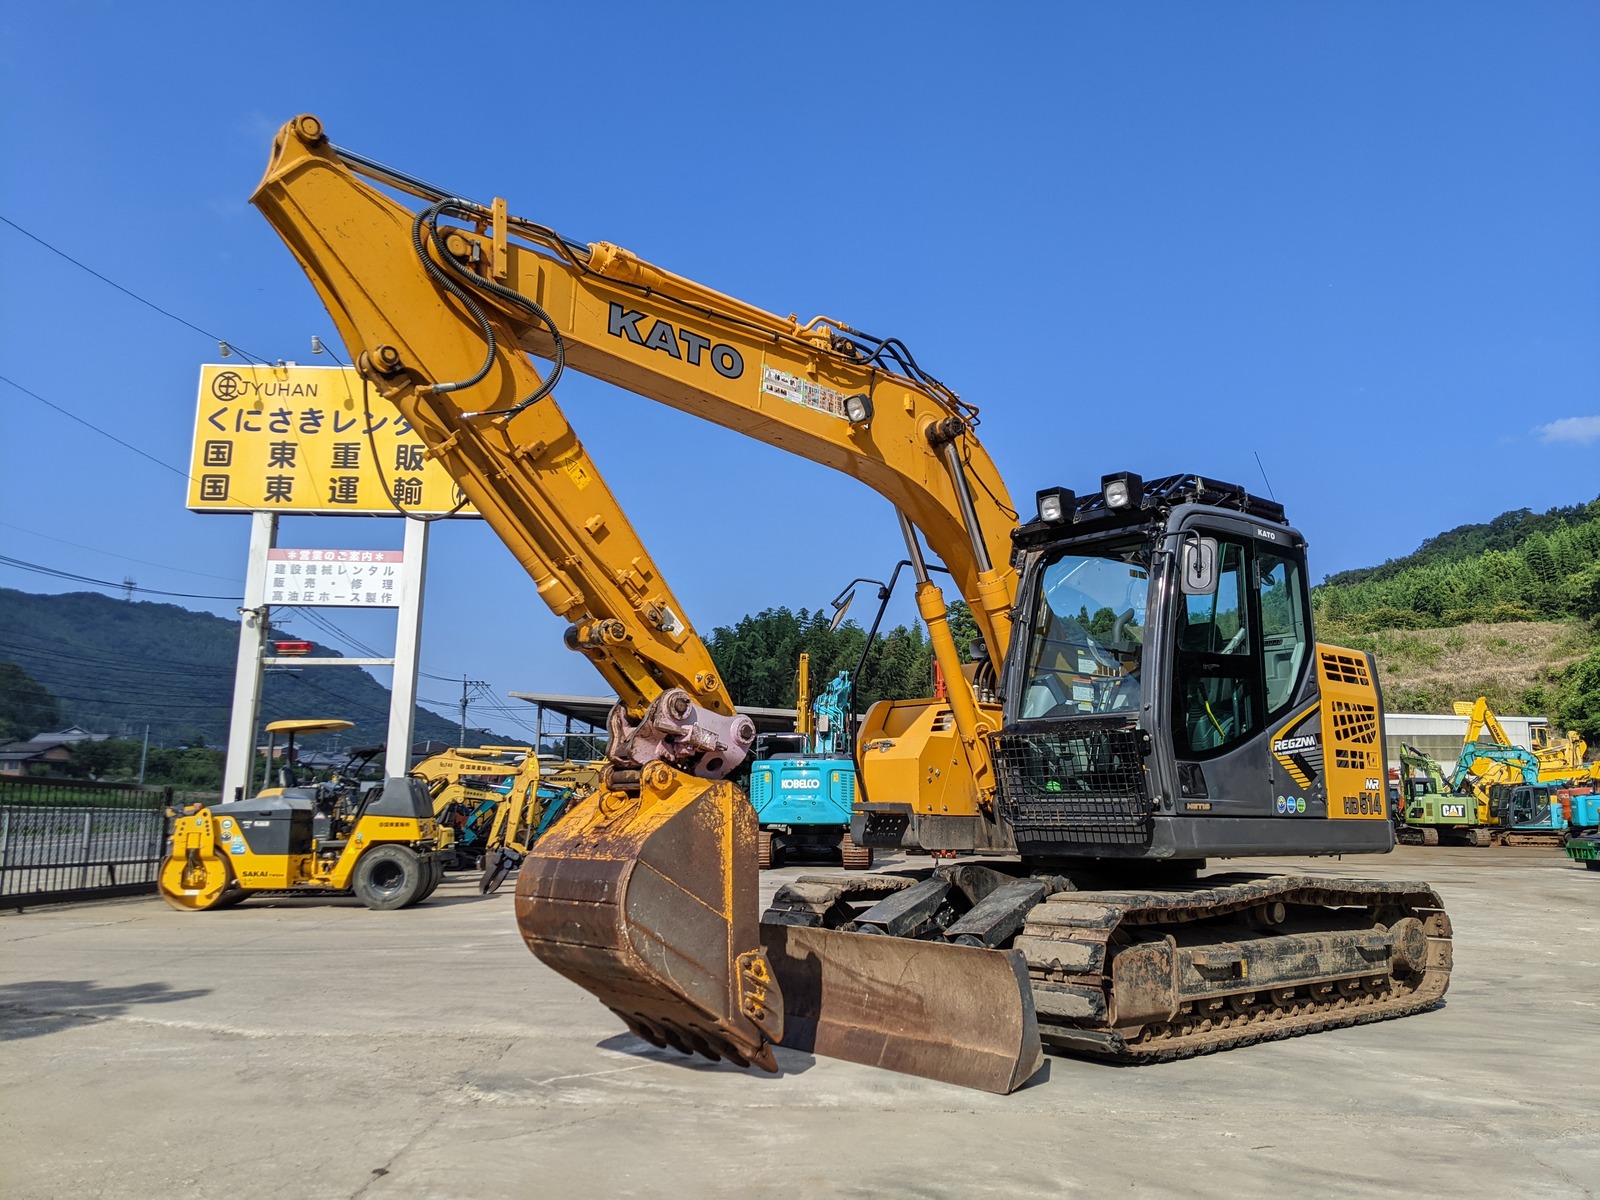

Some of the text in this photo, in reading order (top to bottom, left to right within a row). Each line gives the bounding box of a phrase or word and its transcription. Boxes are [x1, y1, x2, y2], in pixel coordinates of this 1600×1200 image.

[607, 300, 744, 379] KATO
[237, 381, 318, 397] JYUHAN
[203, 440, 426, 471] 国東重販
[1257, 528, 1275, 540] KATO
[274, 563, 394, 576] 建設機械レンタル
[272, 591, 393, 603] 高油圧ホース製作
[781, 779, 820, 789] KOBELCO
[1365, 778, 1380, 791] MR
[1343, 792, 1382, 815] HD514
[1442, 805, 1464, 817] CAT
